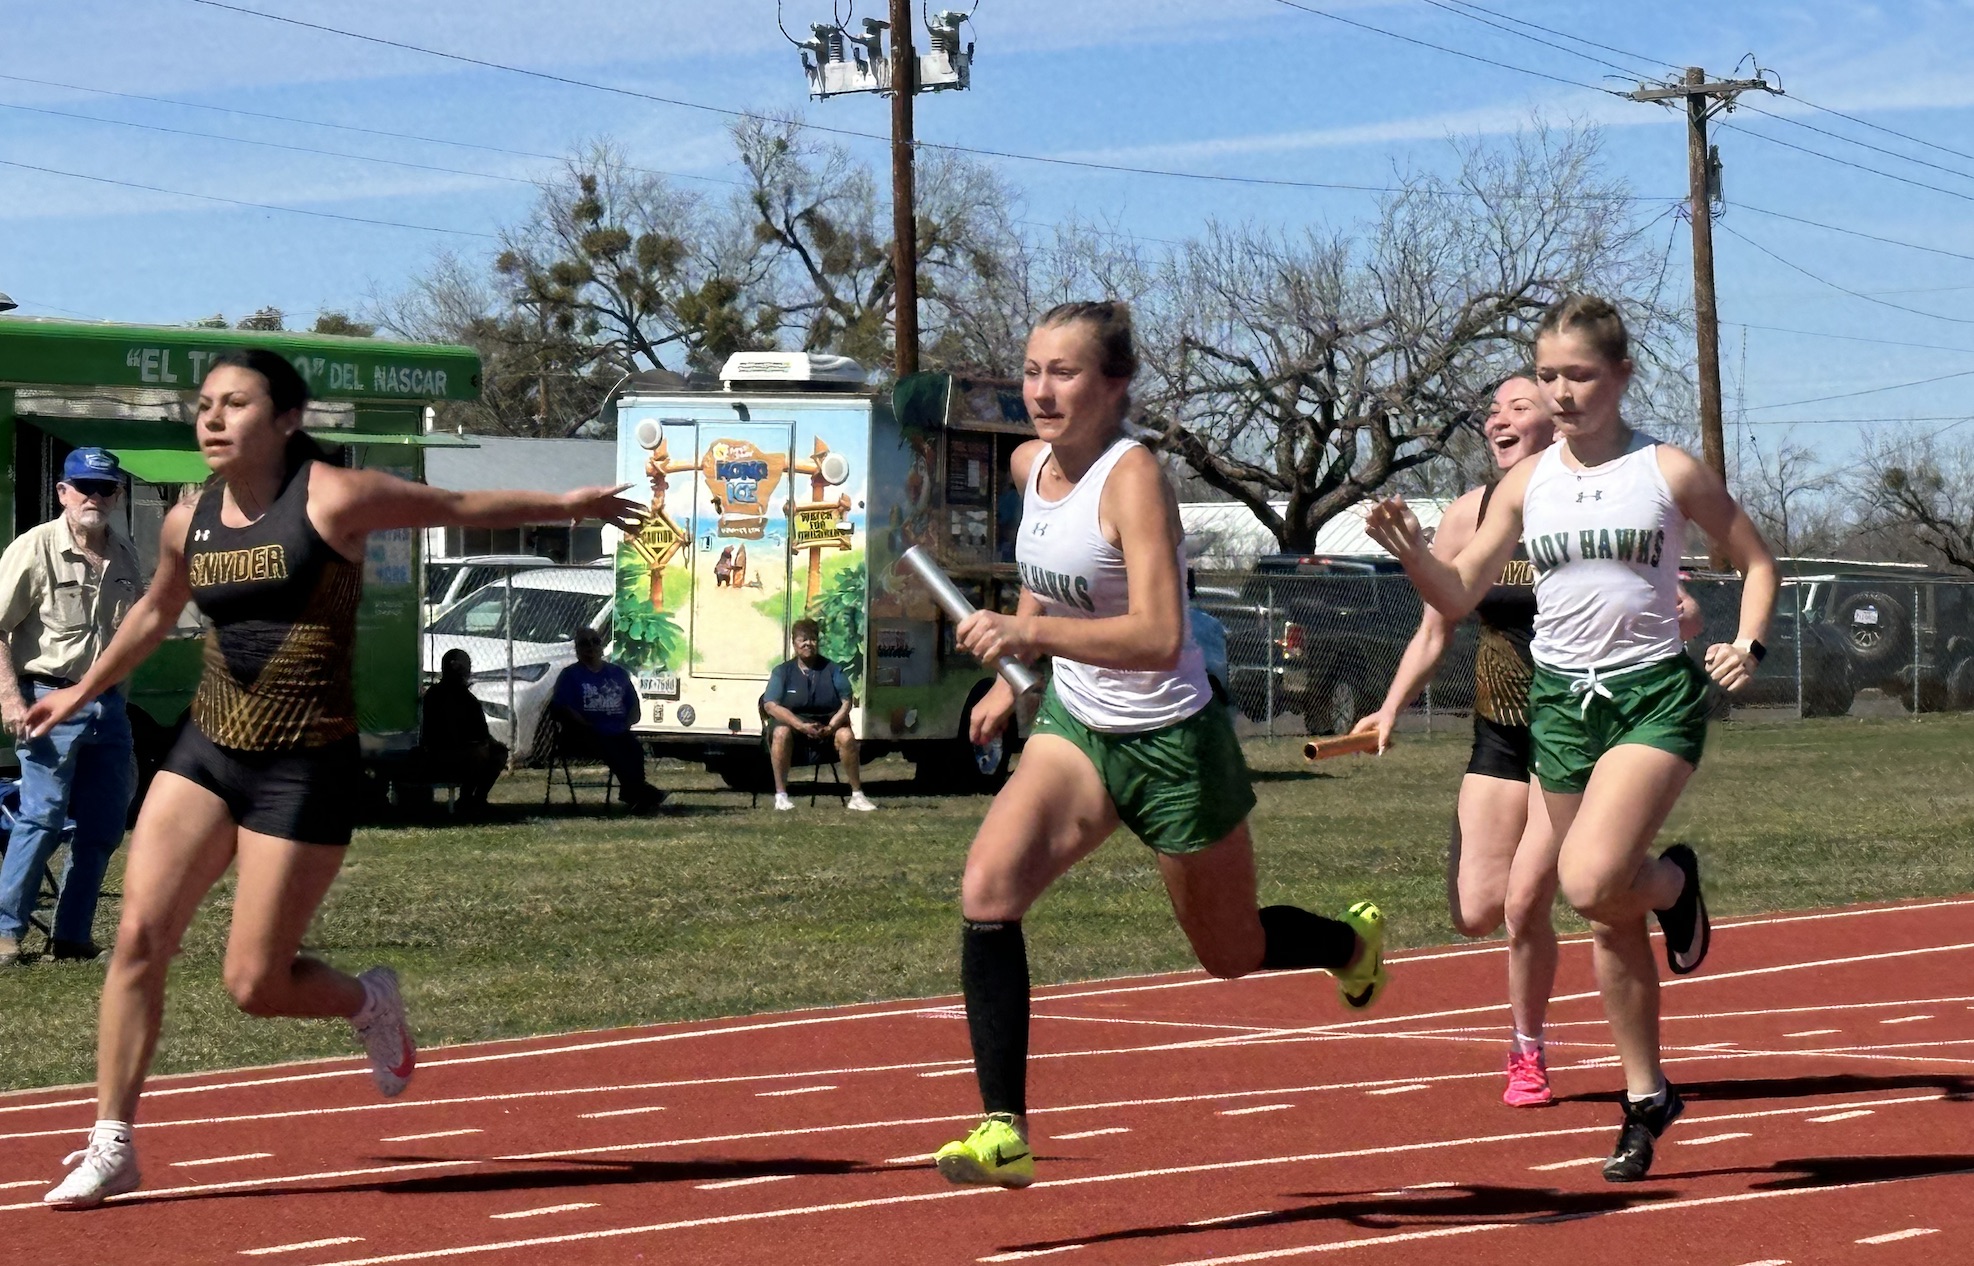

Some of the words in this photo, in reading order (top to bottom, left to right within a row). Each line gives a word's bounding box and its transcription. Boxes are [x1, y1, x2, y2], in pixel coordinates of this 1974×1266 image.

[330, 362, 364, 391] DEL
[374, 365, 447, 396] NASCAR
[189, 544, 289, 587] SNYDER
[1579, 528, 1665, 568] HAWKS
